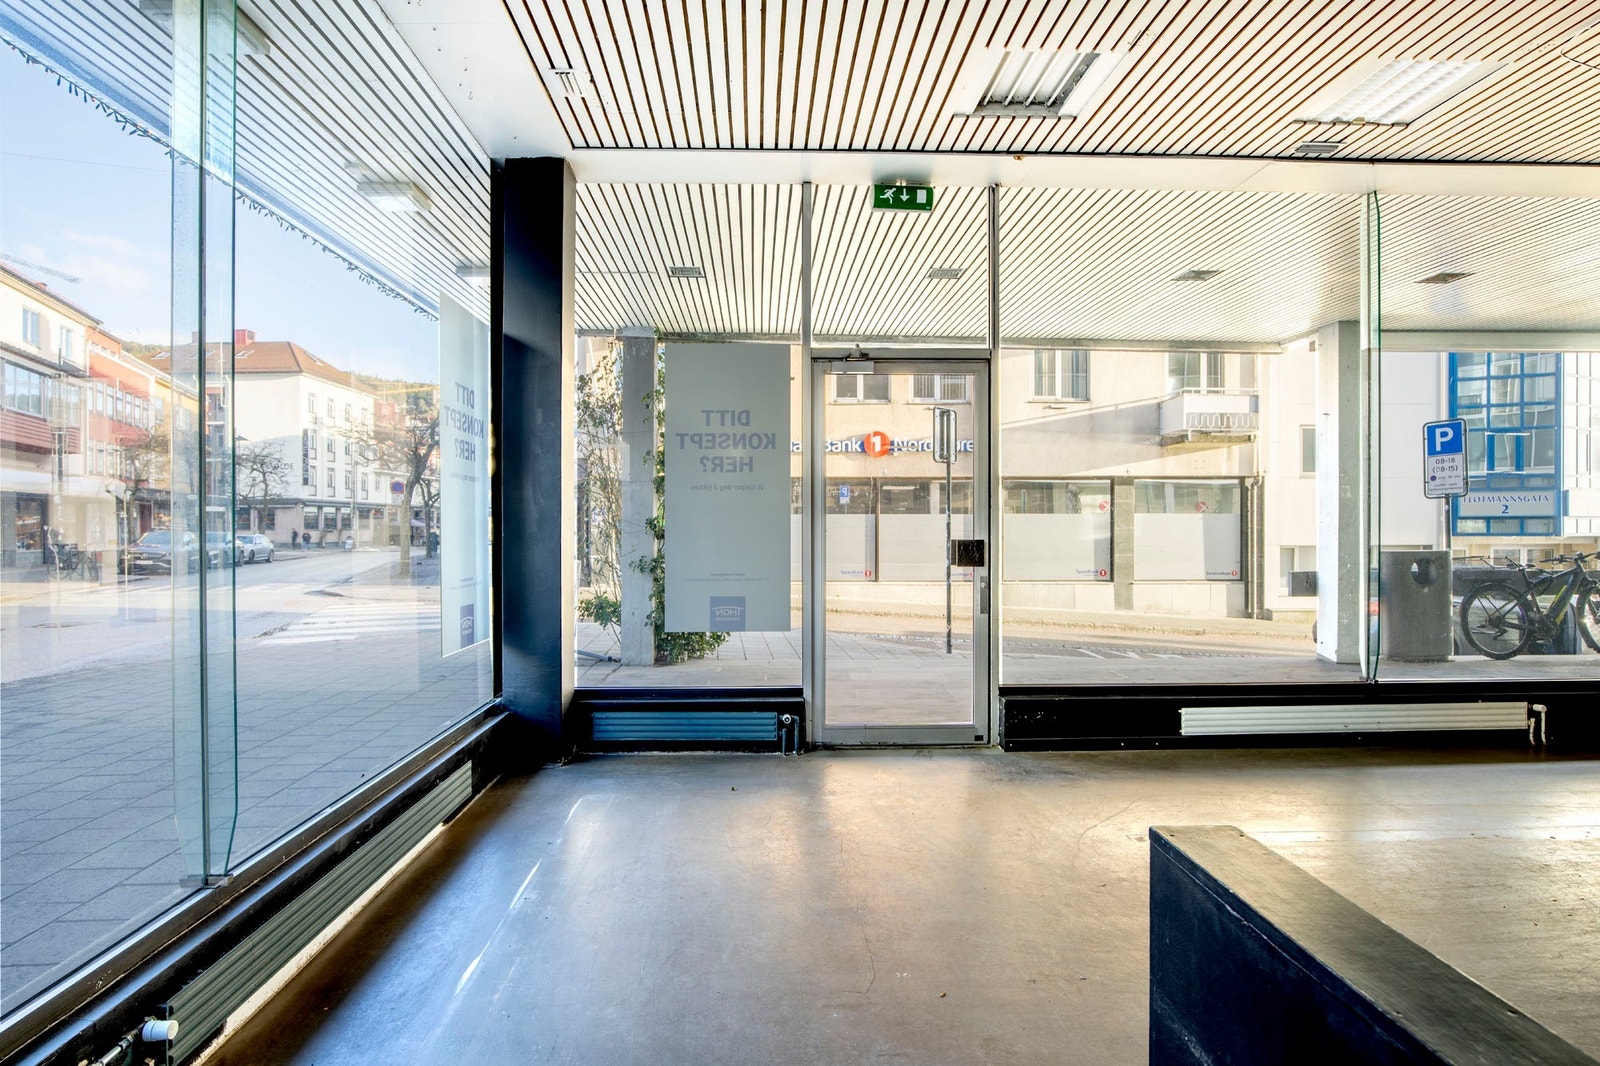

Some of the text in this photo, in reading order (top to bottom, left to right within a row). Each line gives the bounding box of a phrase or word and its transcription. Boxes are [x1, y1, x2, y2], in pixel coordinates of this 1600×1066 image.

[1435, 427, 1454, 452] P
[1435, 457, 1456, 465] 08-18
[1501, 504, 1510, 514] 2
